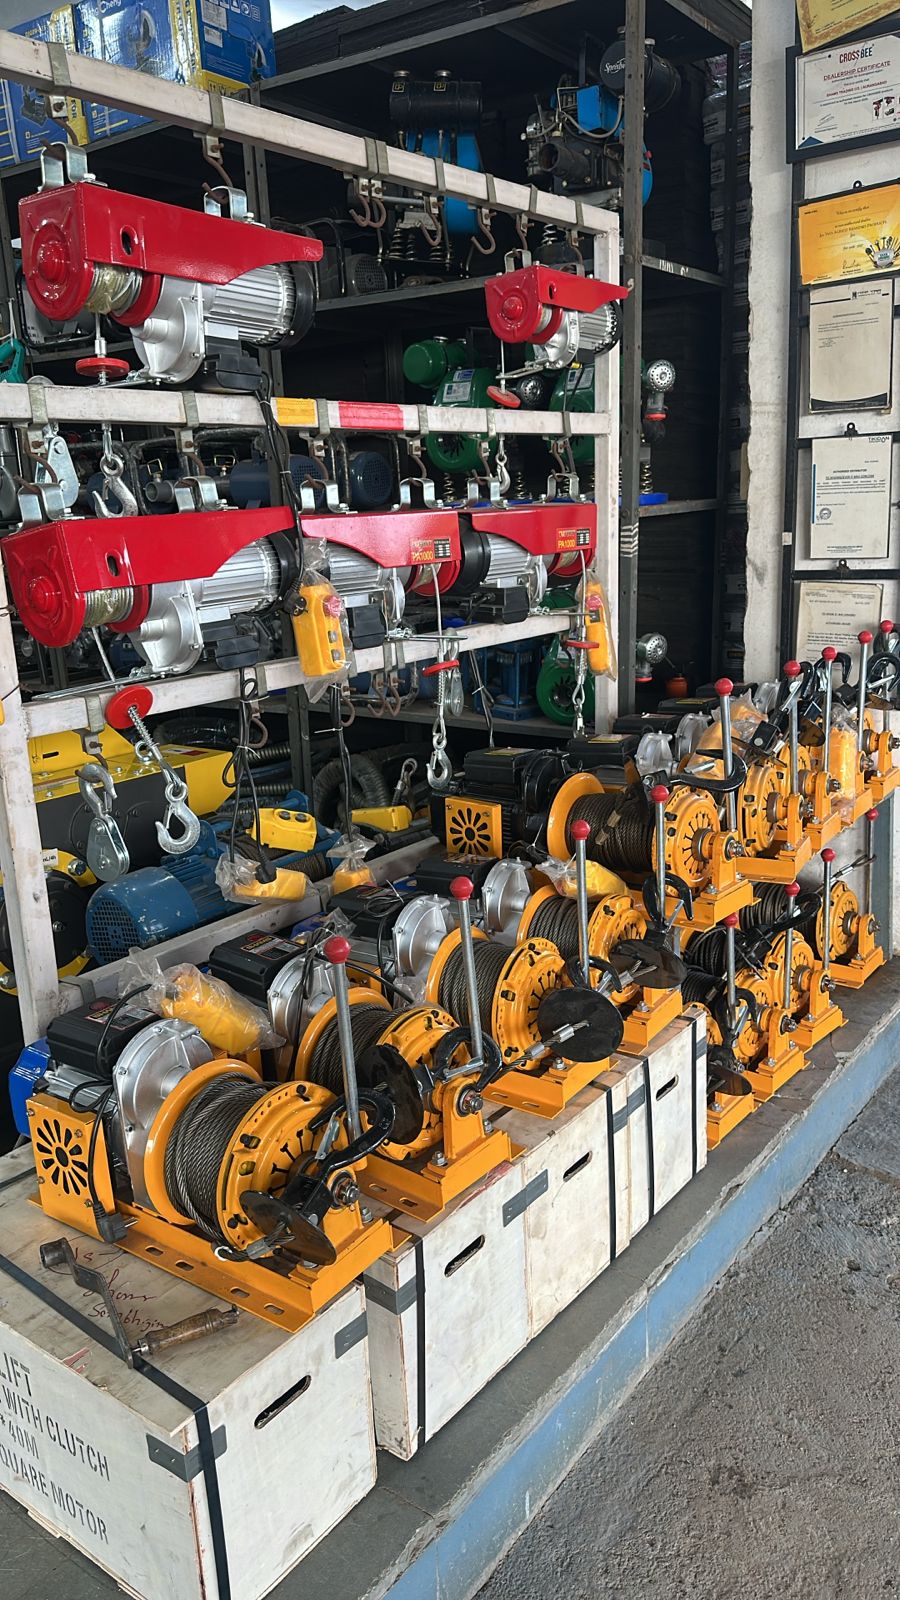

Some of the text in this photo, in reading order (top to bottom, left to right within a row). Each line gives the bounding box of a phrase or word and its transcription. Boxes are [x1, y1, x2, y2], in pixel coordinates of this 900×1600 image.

[823, 68, 856, 81] DEALERSHIP
[857, 60, 891, 73] CERTIFICATE
[2, 1385, 110, 1481] WITH CLUTCH
[50, 1480, 109, 1545] MOTOR
